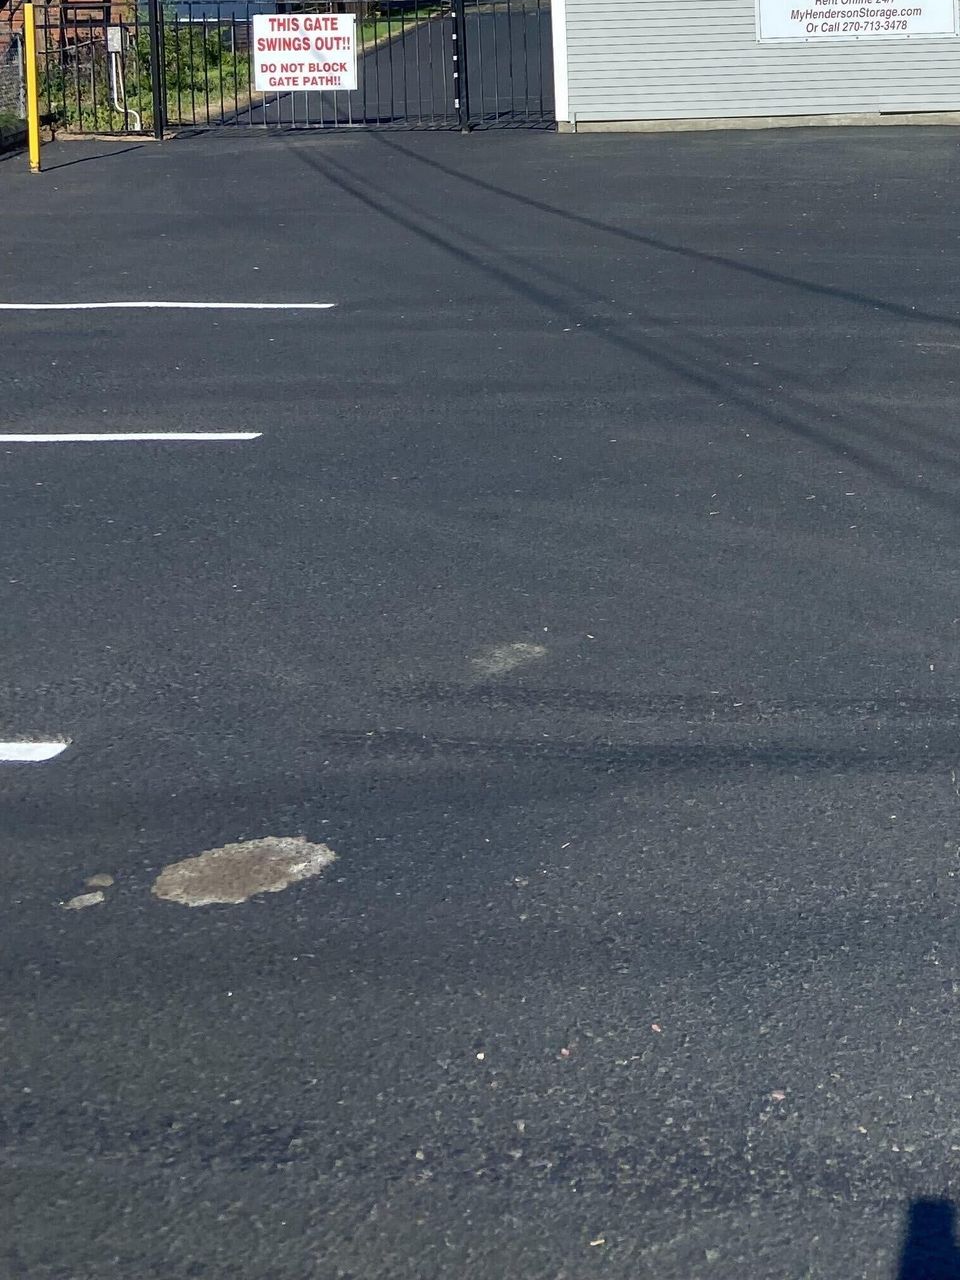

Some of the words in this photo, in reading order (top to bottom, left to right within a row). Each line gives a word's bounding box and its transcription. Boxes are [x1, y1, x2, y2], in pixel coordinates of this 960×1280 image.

[790, 6, 922, 22] MyHendersonStorage.com
[268, 18, 299, 31] THIS
[303, 17, 338, 31] GATE
[806, 22, 818, 33] Or
[821, 21, 840, 32] Call
[842, 19, 908, 31] 270-713-3478
[257, 37, 311, 51] SWINGS
[315, 36, 351, 51] OUT!!
[261, 63, 277, 73] DO
[280, 63, 304, 73] NOT
[308, 62, 348, 72] BLOCK
[269, 76, 299, 87] GATE
[303, 75, 342, 86] PATH!!
